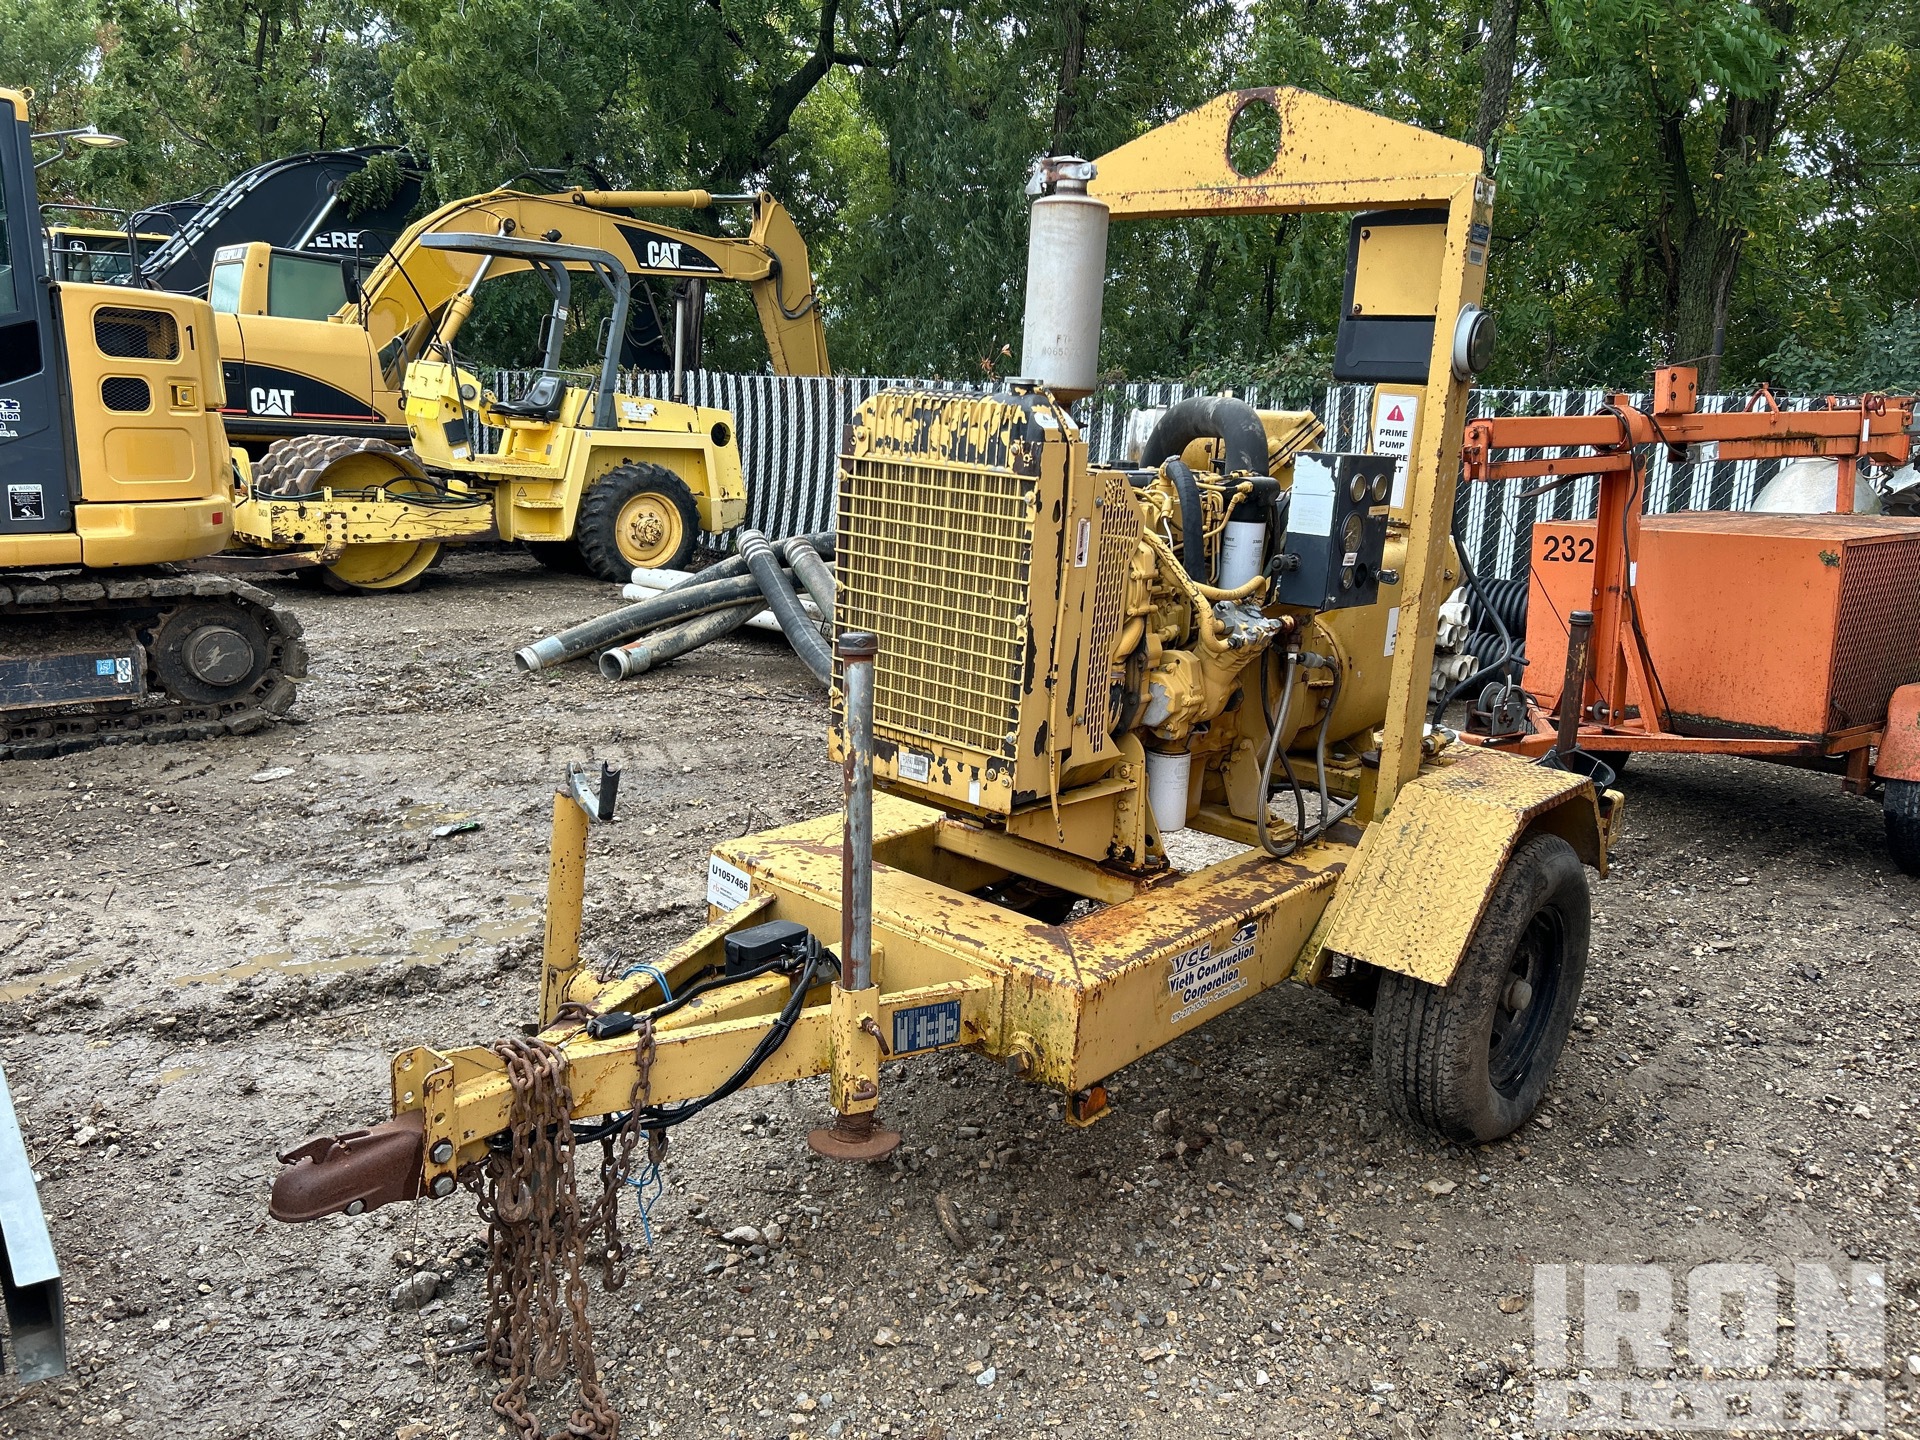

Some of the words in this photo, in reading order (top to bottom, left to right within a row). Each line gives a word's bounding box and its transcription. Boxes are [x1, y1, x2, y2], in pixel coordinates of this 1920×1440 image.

[307, 231, 364, 249] ERE
[647, 240, 682, 269] CAT
[185, 325, 195, 351] 1
[250, 386, 295, 417] CAT
[1379, 428, 1408, 438] PRIME
[1379, 440, 1405, 449] PUMP
[1543, 535, 1595, 563] 232
[712, 864, 748, 892] U1057466
[1170, 972, 1195, 993] Vieth
[1197, 945, 1254, 981] Construction
[1171, 943, 1211, 973] VCC
[1183, 968, 1239, 1003] Corporation
